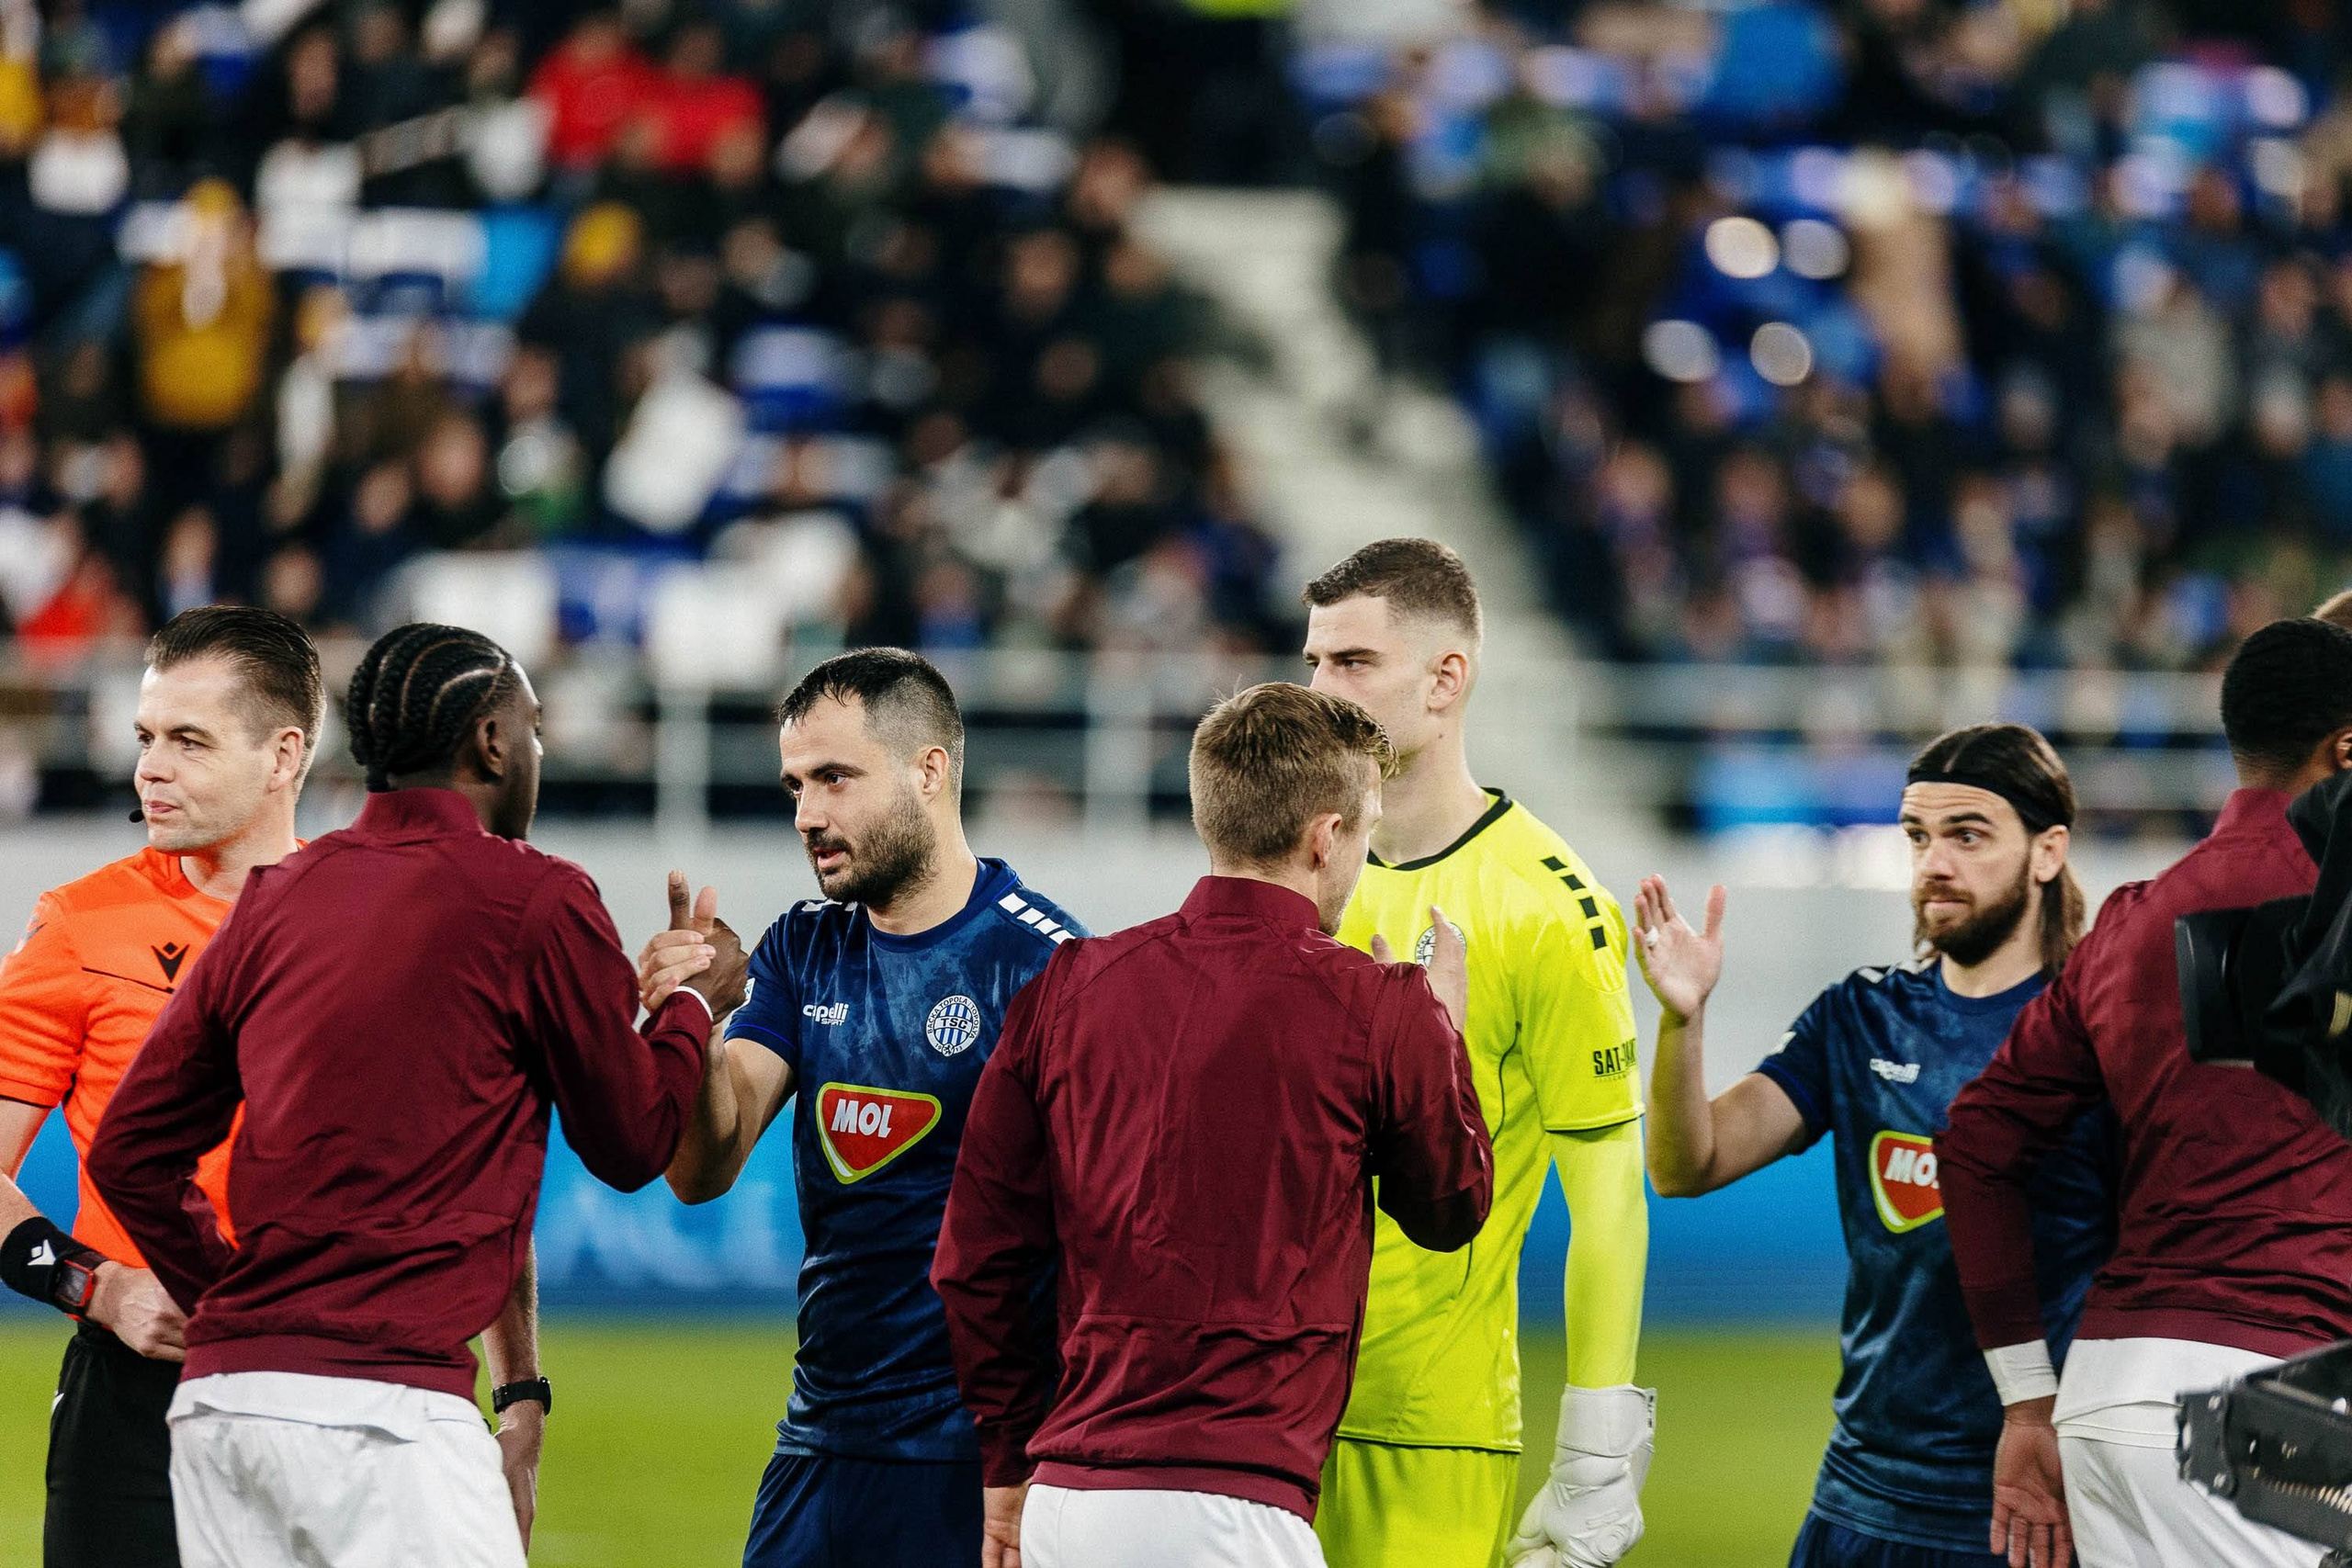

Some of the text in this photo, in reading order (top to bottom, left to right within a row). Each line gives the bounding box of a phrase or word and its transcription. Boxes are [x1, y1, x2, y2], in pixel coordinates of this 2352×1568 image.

[940, 1017, 968, 1030] TSC
[831, 1098, 893, 1138] MOL
[1883, 1146, 1939, 1190] MO
